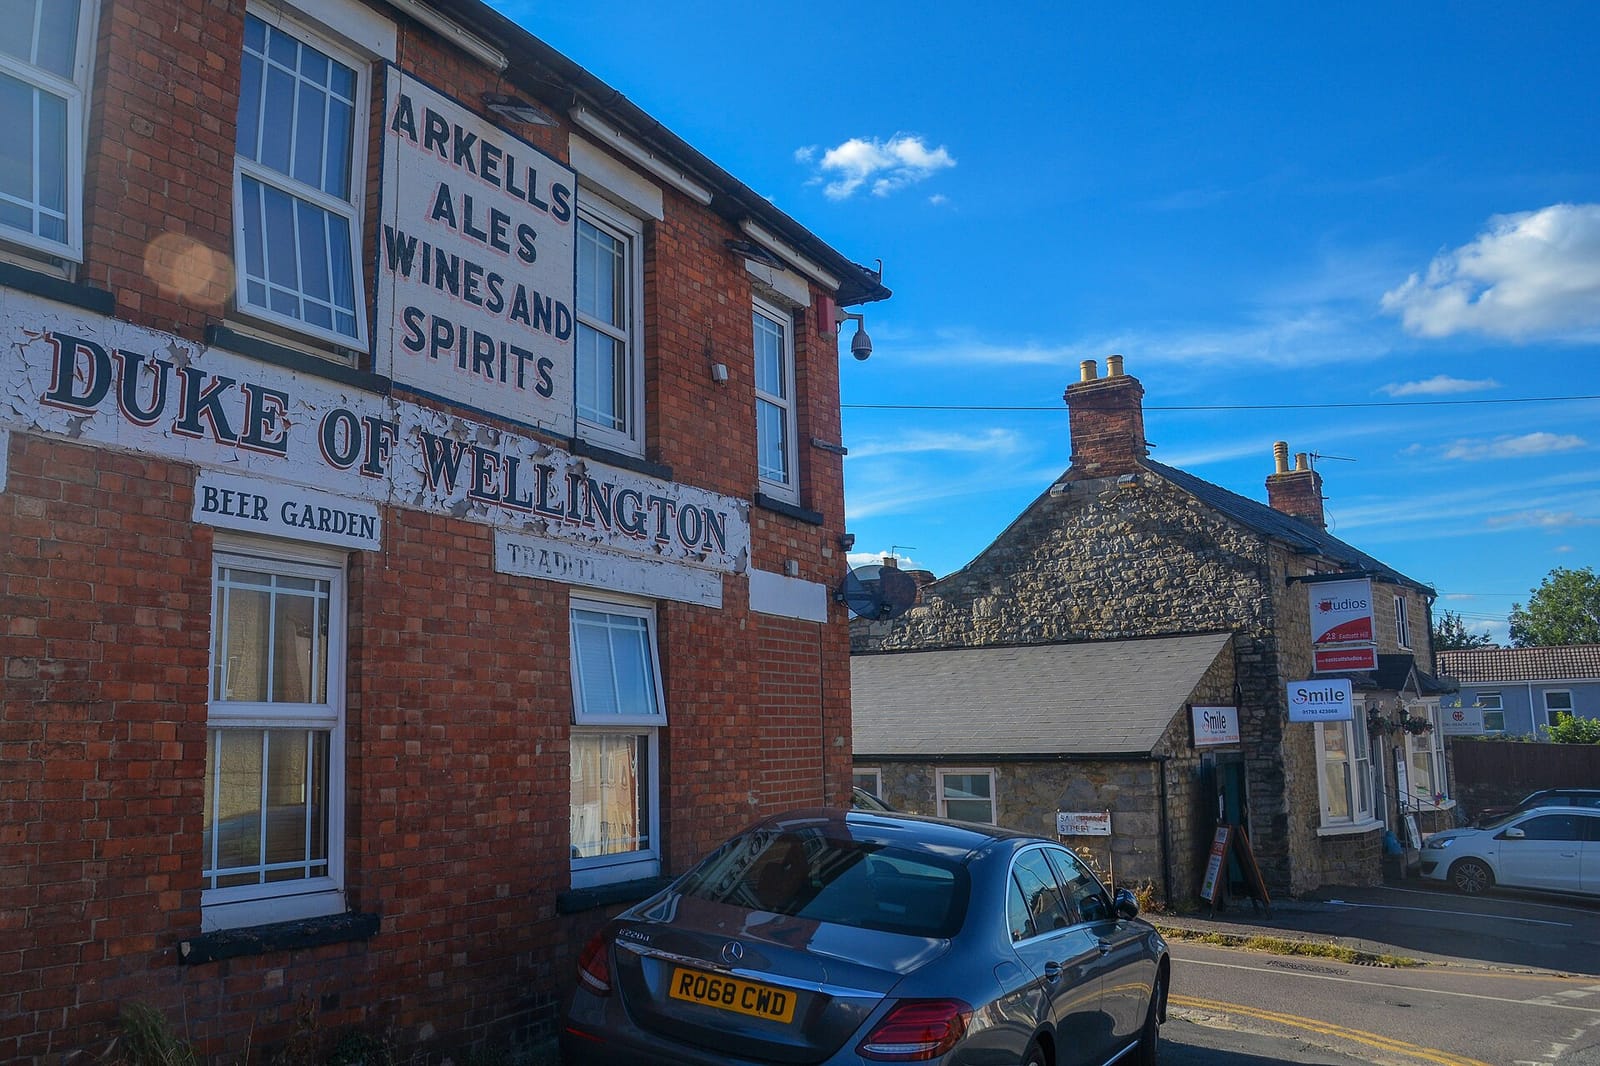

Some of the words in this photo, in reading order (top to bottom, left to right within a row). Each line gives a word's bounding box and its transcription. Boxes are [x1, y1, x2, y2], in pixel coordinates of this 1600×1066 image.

[389, 93, 571, 223] ARKELLS
[427, 182, 537, 265] ALES
[382, 224, 505, 315] WINES
[509, 283, 572, 342] AND
[400, 305, 554, 399] SPIRITS
[40, 331, 289, 457] DUKE
[318, 408, 399, 479] OF
[418, 431, 728, 555] WELLINGTON
[201, 485, 269, 522] BEER
[280, 501, 376, 540] GARDEN
[1202, 711, 1227, 731] Smile
[1294, 688, 1345, 704] Smile
[679, 973, 737, 1005] RO68
[741, 987, 787, 1015] CWD
